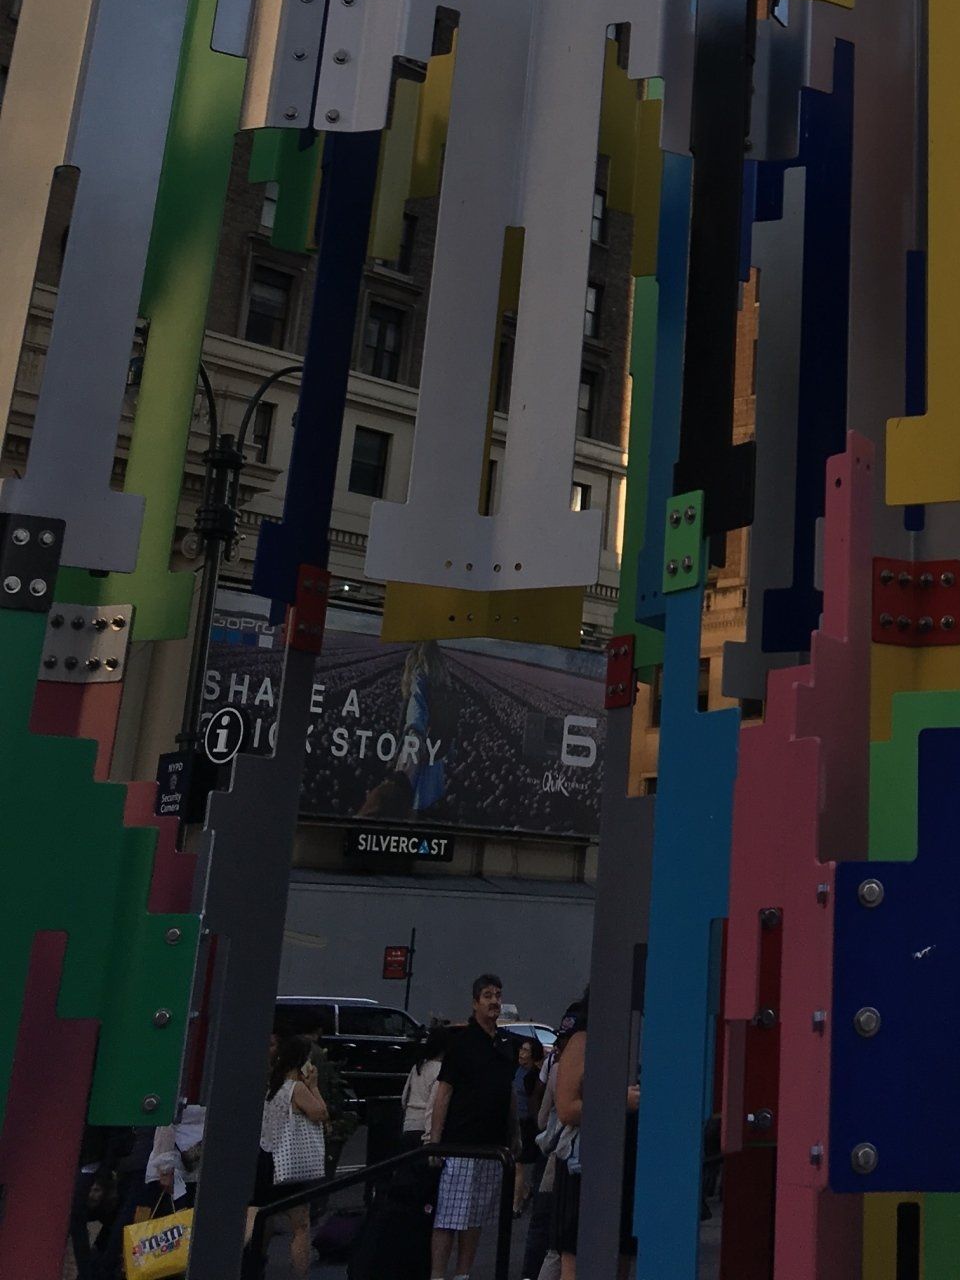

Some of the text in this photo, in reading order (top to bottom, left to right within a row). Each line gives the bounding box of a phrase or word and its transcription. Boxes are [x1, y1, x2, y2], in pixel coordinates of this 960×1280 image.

[203, 669, 360, 718] SHAE A
[330, 727, 442, 766] STORY
[561, 715, 598, 768] 6
[168, 762, 183, 773] NYPD
[357, 833, 448, 856] SILVERCAST
